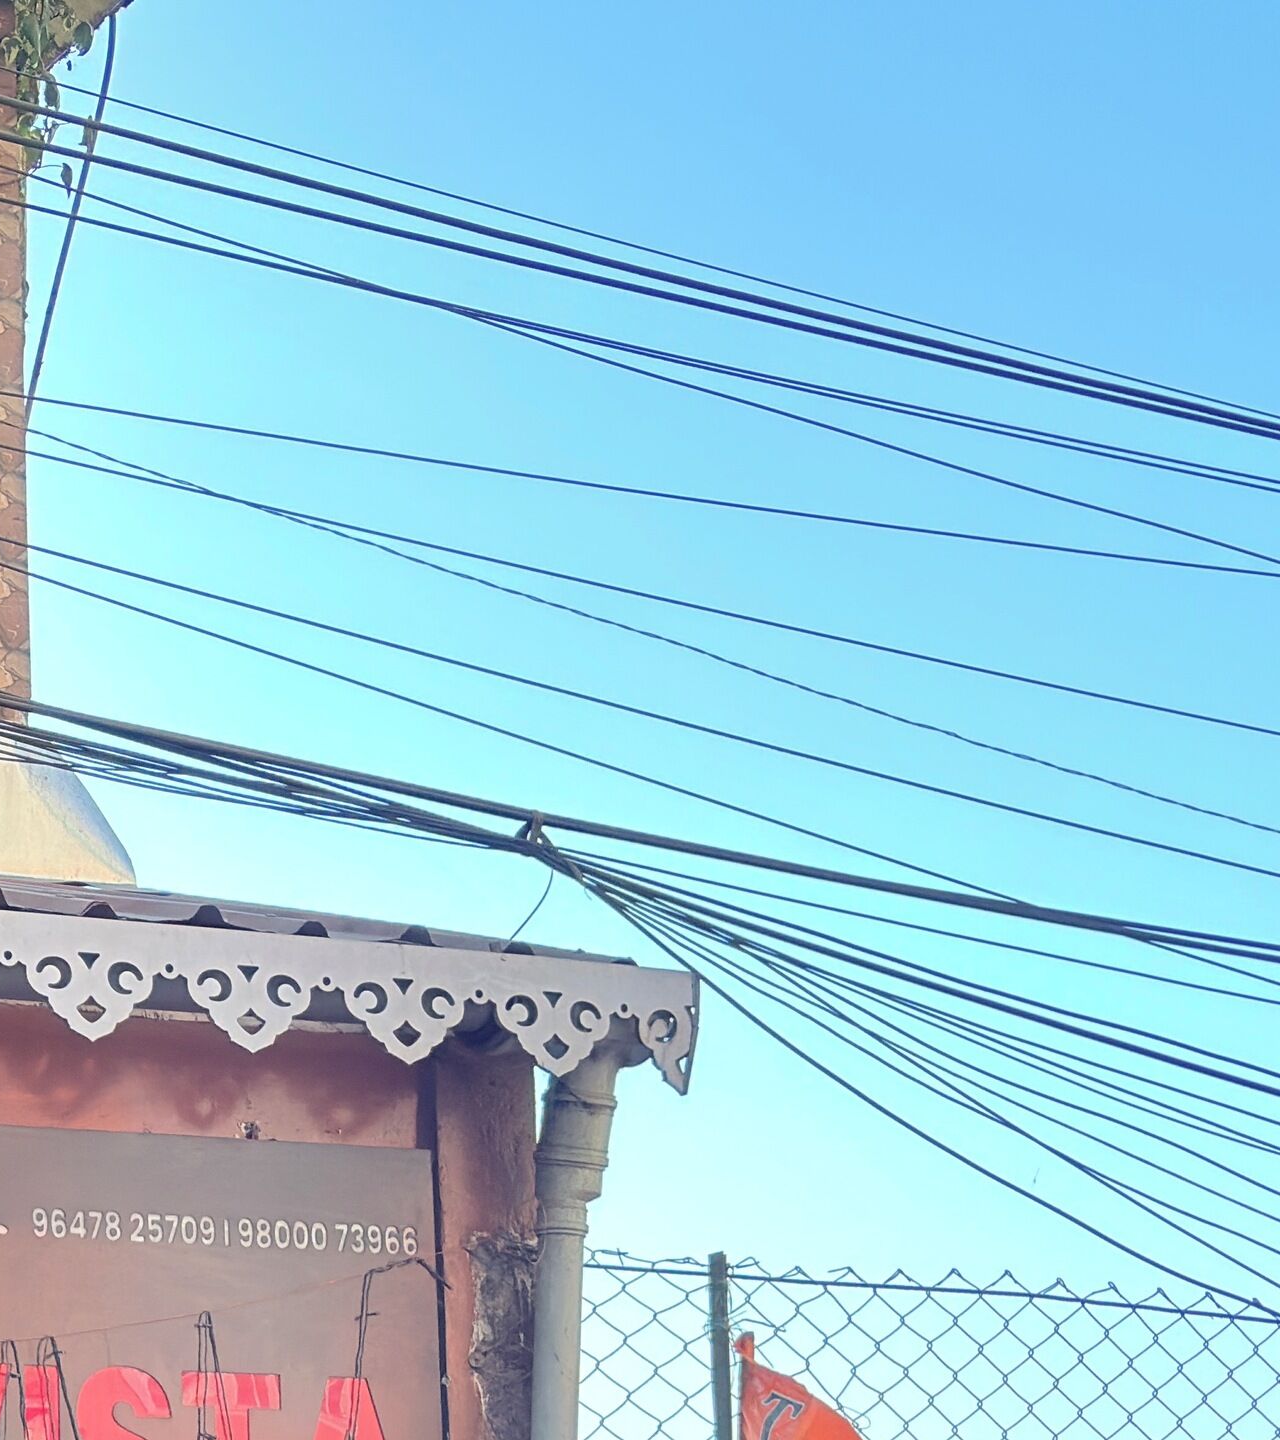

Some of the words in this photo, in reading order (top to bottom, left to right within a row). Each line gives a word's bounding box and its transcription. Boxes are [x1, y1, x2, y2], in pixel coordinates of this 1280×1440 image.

[32, 1207, 122, 1241] 96478
[130, 1212, 216, 1246] 25709
[239, 1217, 328, 1251] 98000
[335, 1222, 419, 1256] 73966
